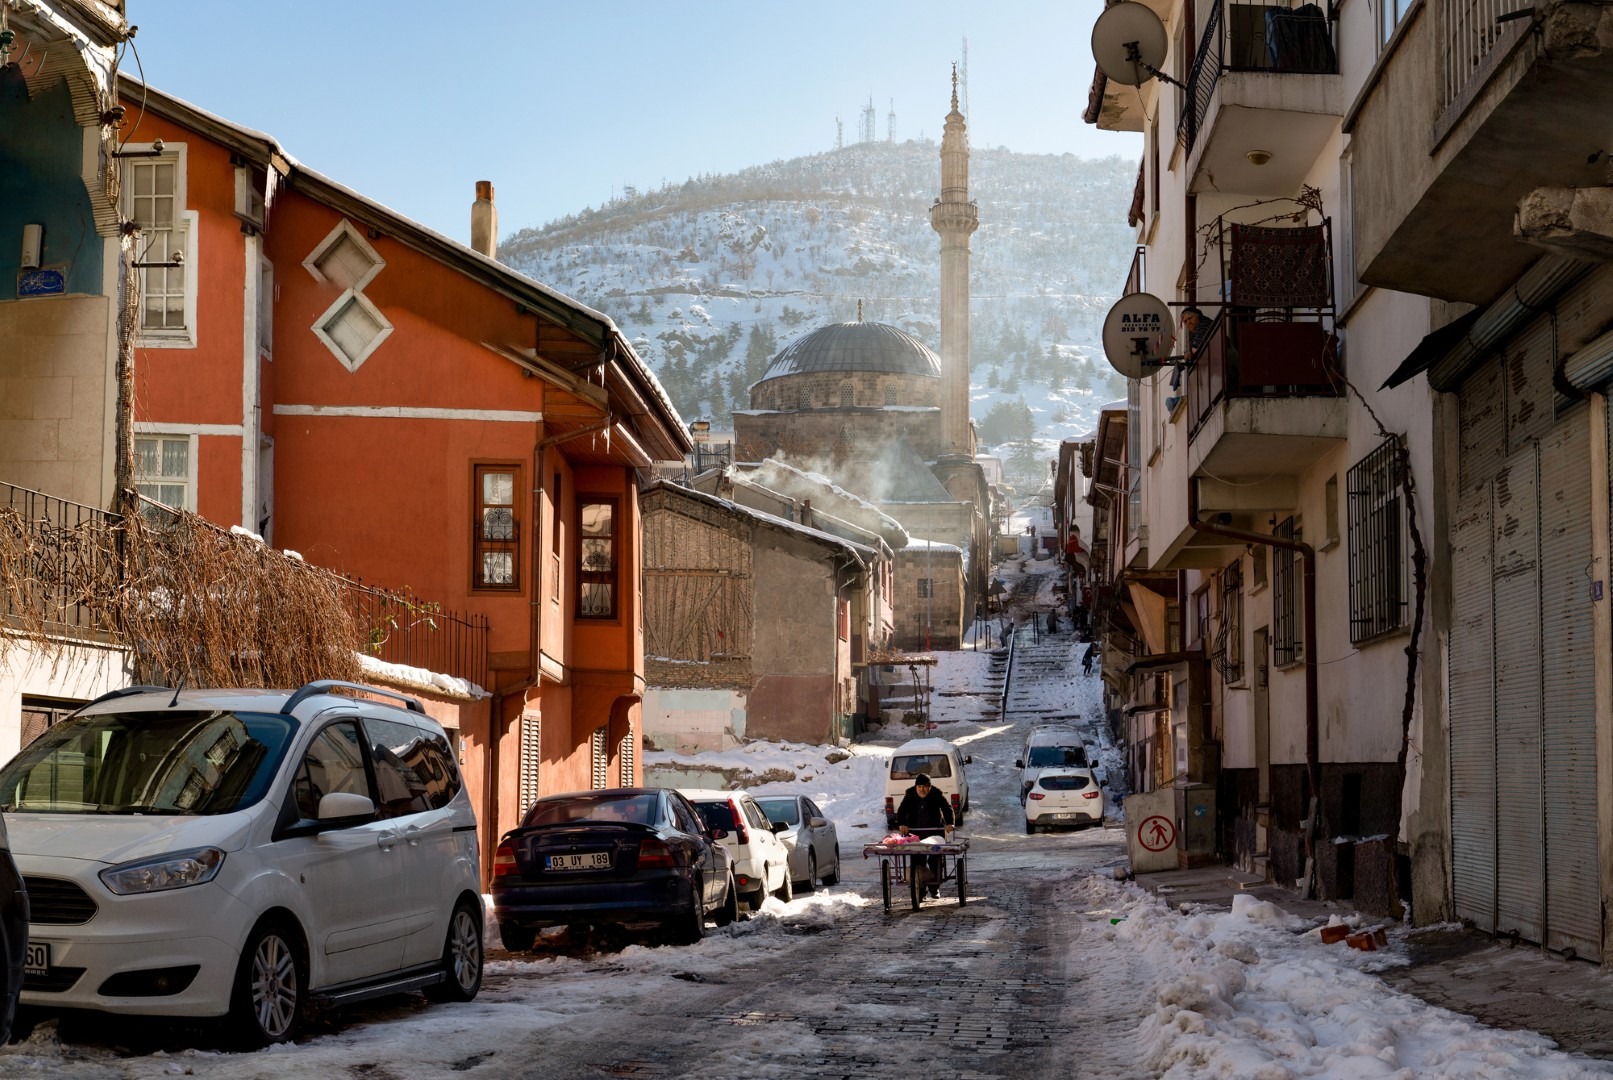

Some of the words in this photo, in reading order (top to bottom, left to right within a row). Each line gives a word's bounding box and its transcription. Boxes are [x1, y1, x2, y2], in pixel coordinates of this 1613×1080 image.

[1122, 314, 1160, 323] ALFA
[552, 856, 564, 867] 03
[571, 855, 582, 865] UY
[592, 854, 608, 864] 189
[26, 947, 44, 966] 60
